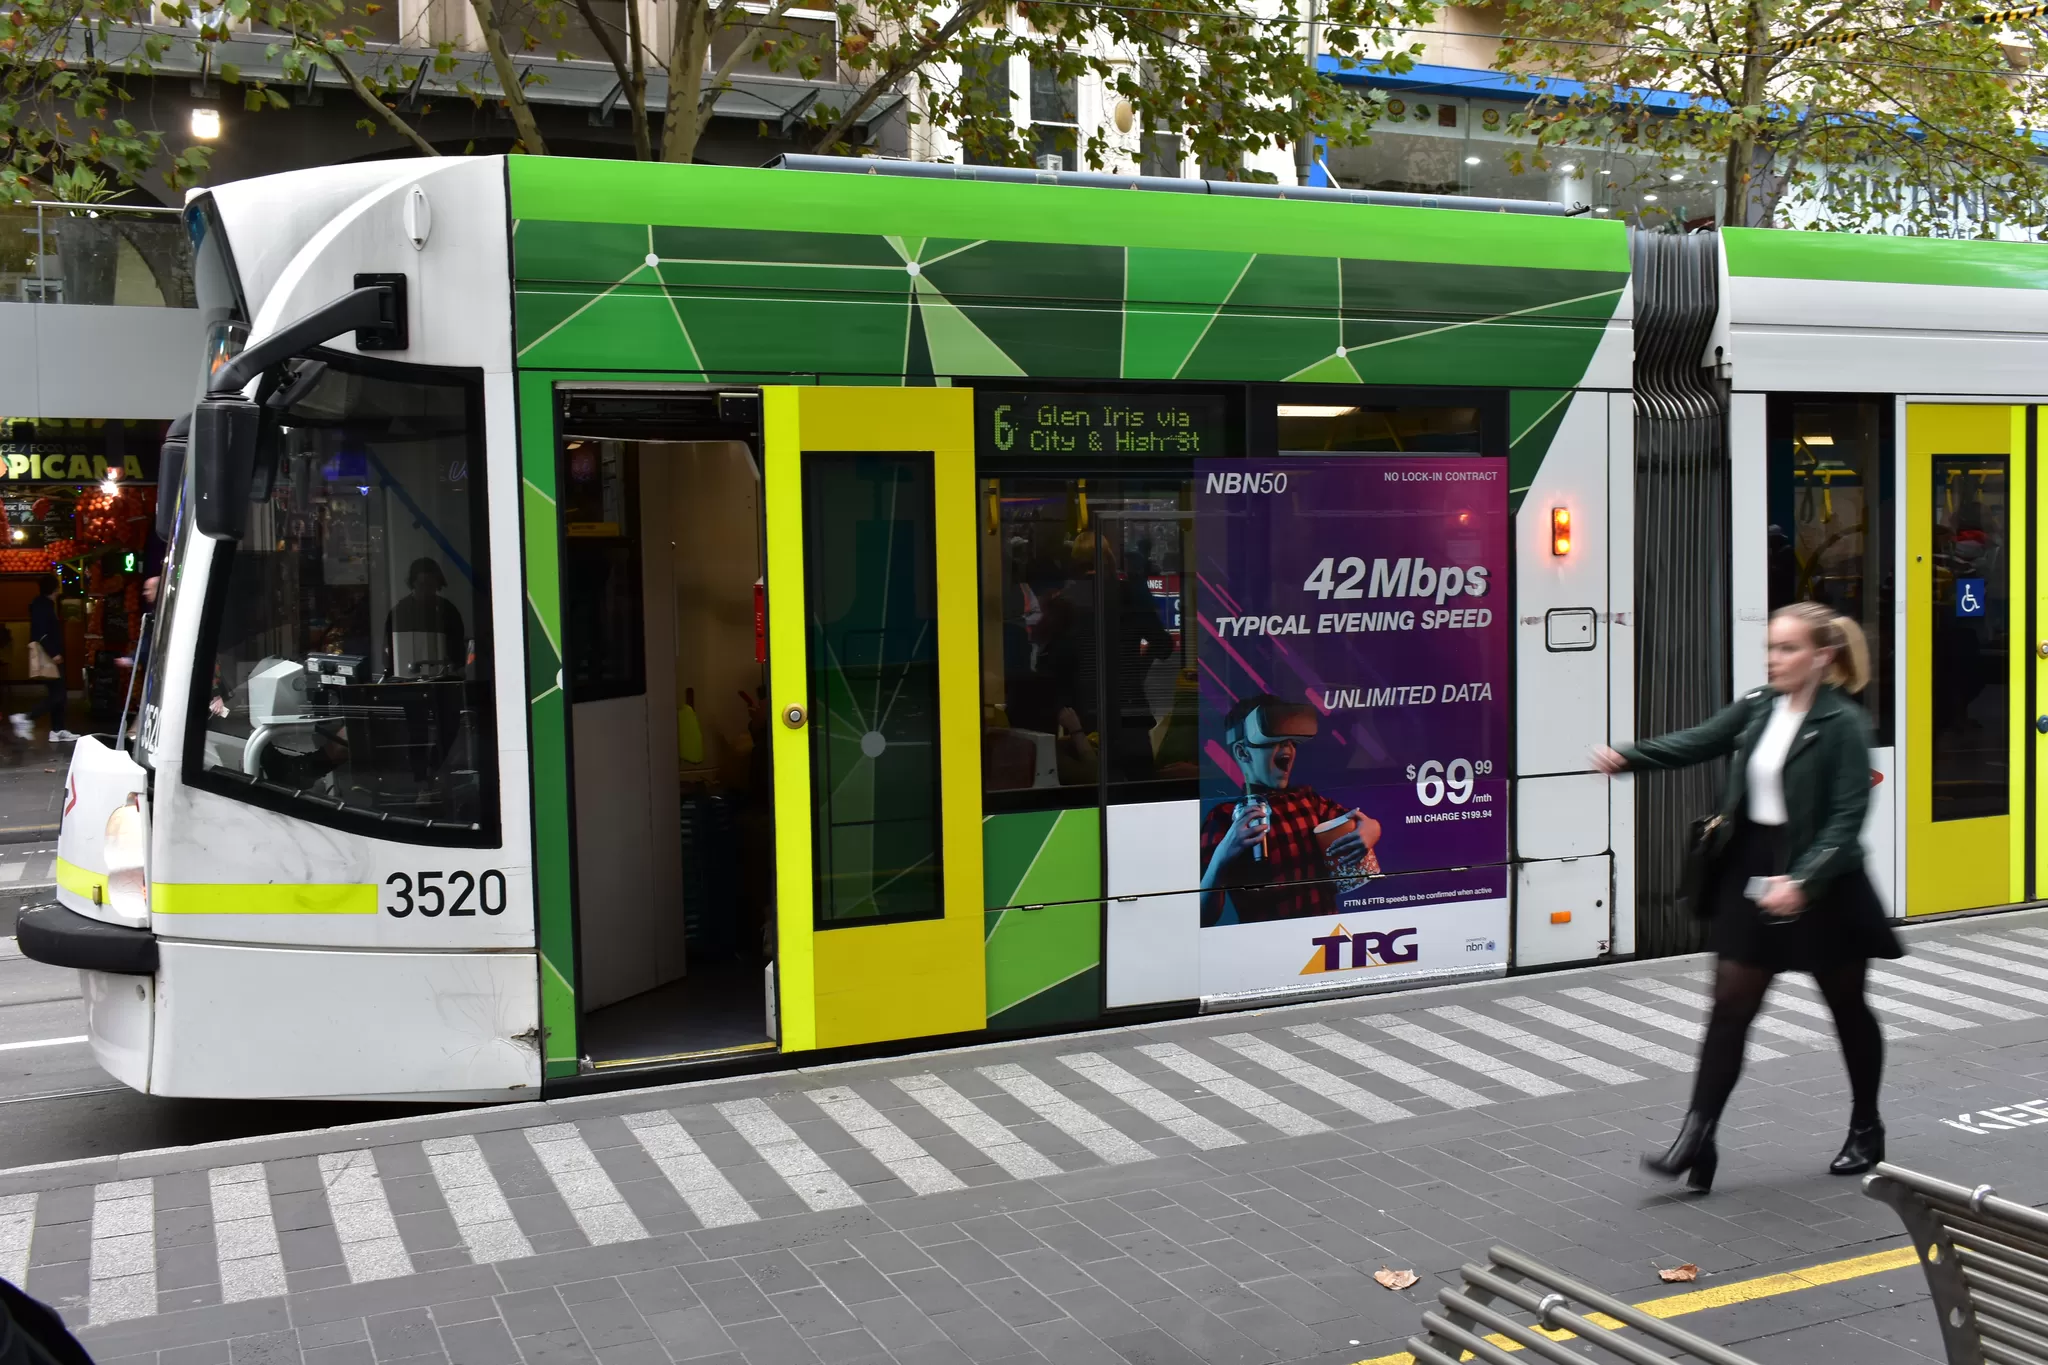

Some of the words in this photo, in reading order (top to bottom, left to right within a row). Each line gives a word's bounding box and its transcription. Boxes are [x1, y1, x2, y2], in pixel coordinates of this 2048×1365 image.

[994, 405, 1014, 450] 6
[1038, 406, 1090, 426] Glen
[1104, 406, 1144, 426] Iris
[1157, 408, 1189, 426] via
[1030, 431, 1075, 451] City
[1089, 431, 1102, 451] &
[1116, 431, 1164, 451] High
[1177, 431, 1200, 451] St
[1206, 473, 1288, 494] NBN50
[1384, 472, 1399, 481] NO
[1402, 472, 1443, 481] LOCK-IN
[1445, 471, 1498, 481] CONTRACT
[1216, 615, 1310, 637] TYPICAL
[1317, 611, 1415, 633] EVENING
[1420, 608, 1493, 630] SPEED
[1323, 686, 1437, 709] UNLIMITED
[1442, 682, 1493, 703] DATA
[1405, 815, 1422, 824] MIN
[1424, 812, 1460, 822] CHARGE
[1461, 809, 1492, 819] $199.94
[385, 869, 507, 918] 3520
[1386, 895, 1409, 904] speeds
[1426, 890, 1457, 899] confirmed
